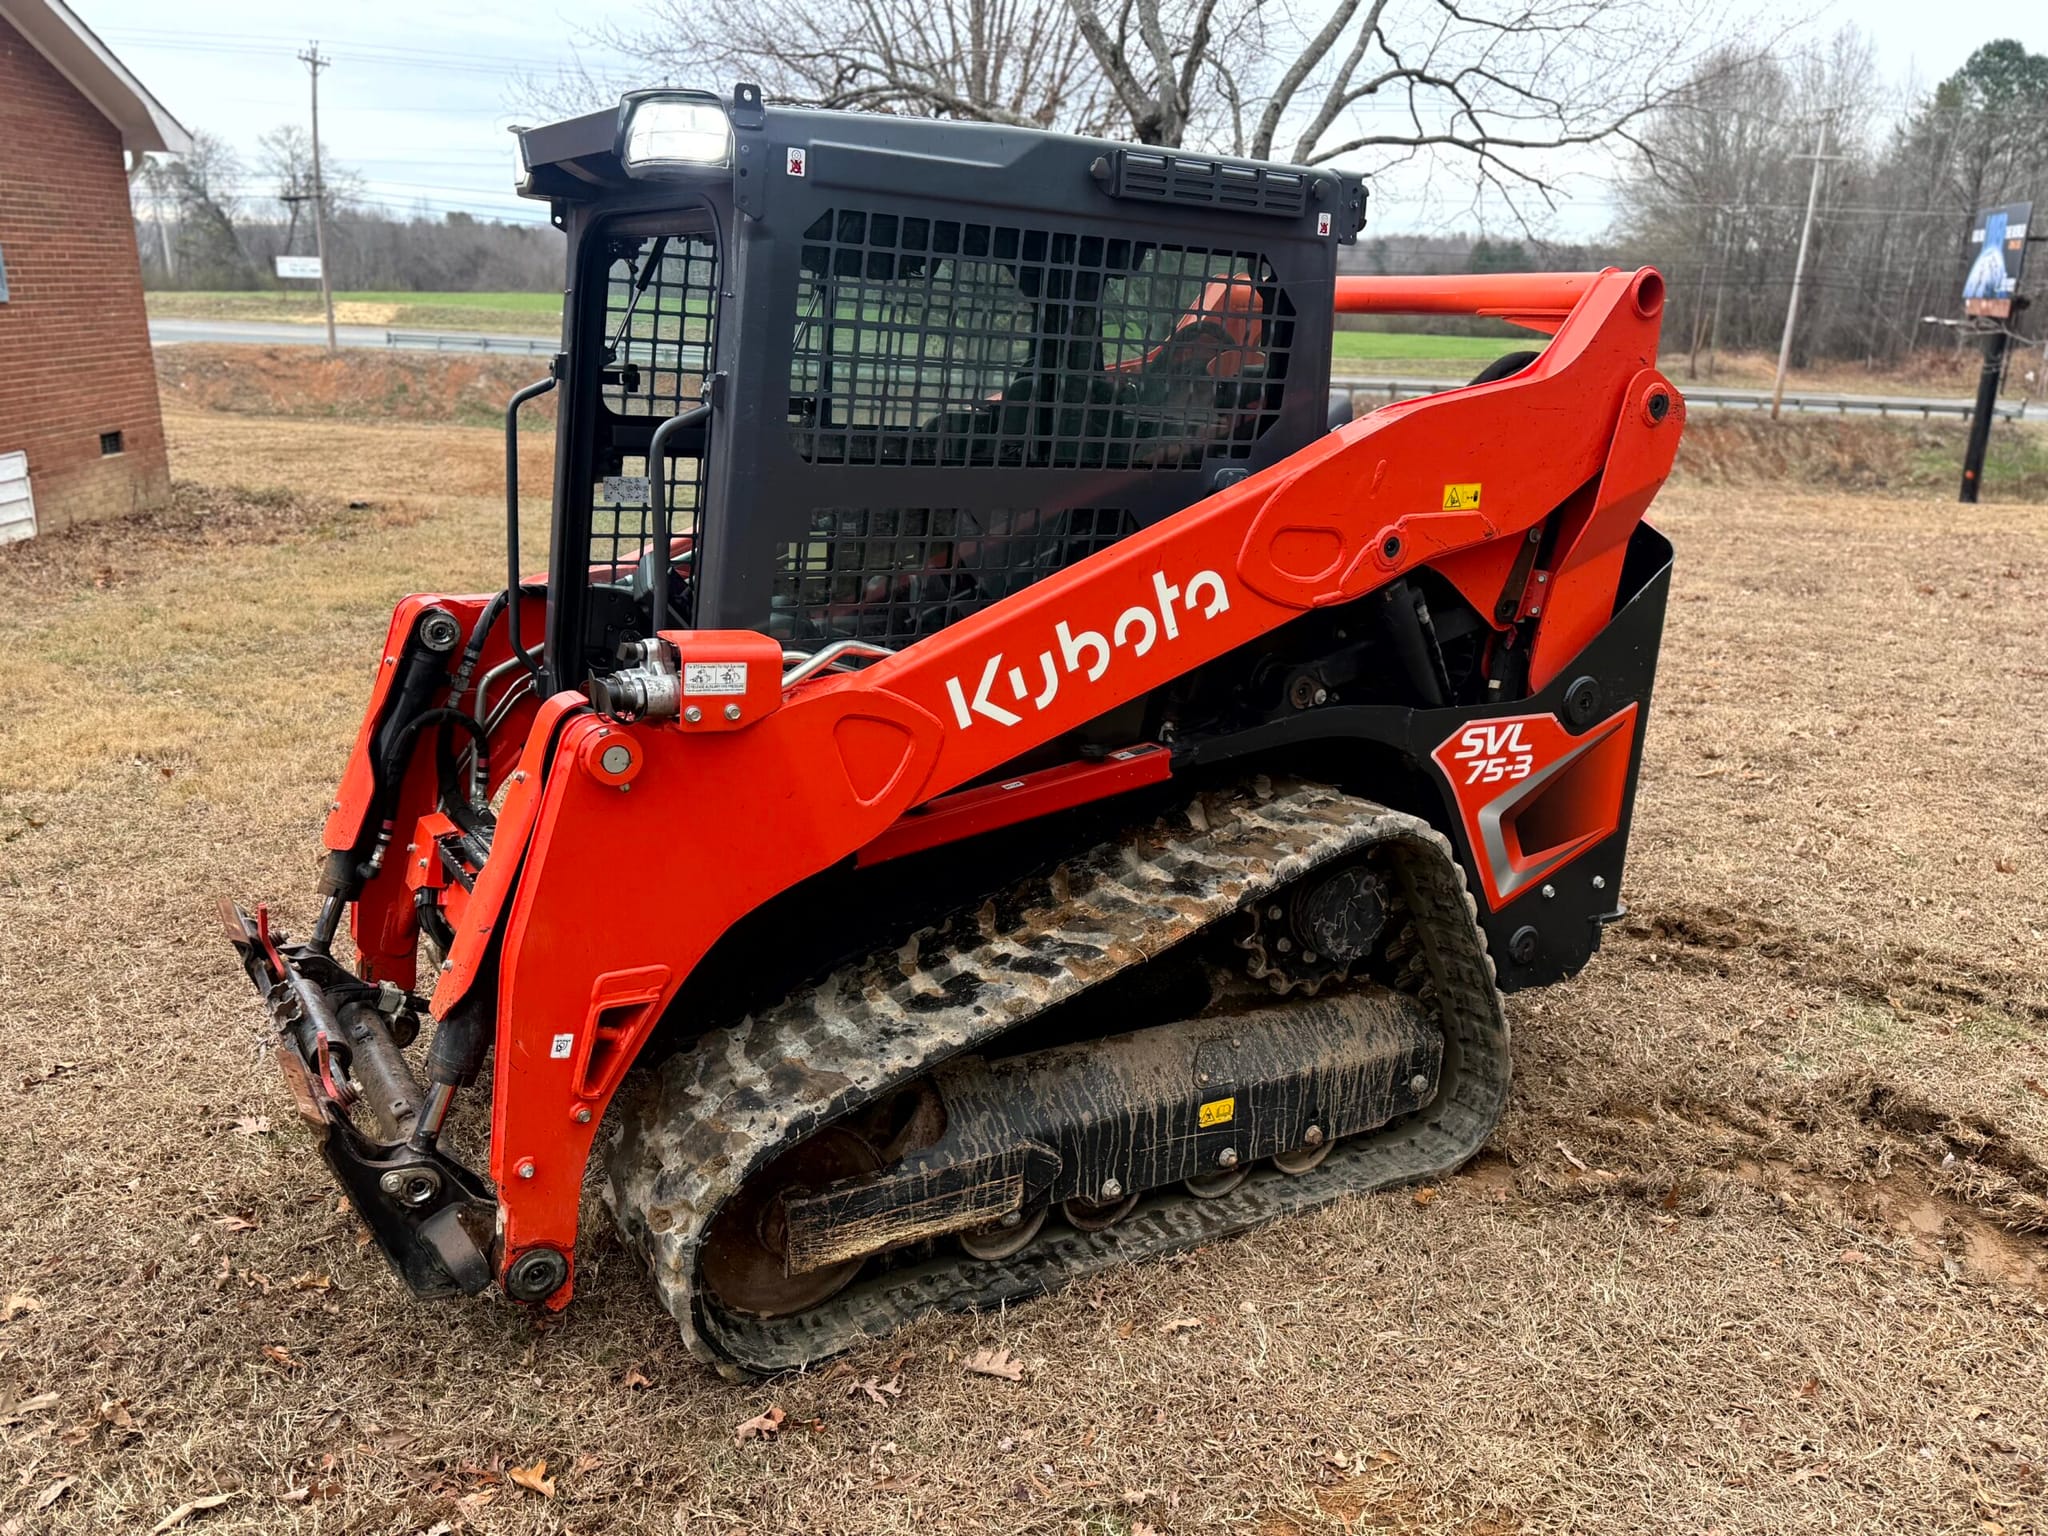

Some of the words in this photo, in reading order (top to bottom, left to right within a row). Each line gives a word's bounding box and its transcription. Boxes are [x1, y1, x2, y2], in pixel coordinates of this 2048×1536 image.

[945, 570, 1230, 730] Kubota
[1454, 723, 1532, 759] SVL
[1465, 755, 1533, 785] 75-3
